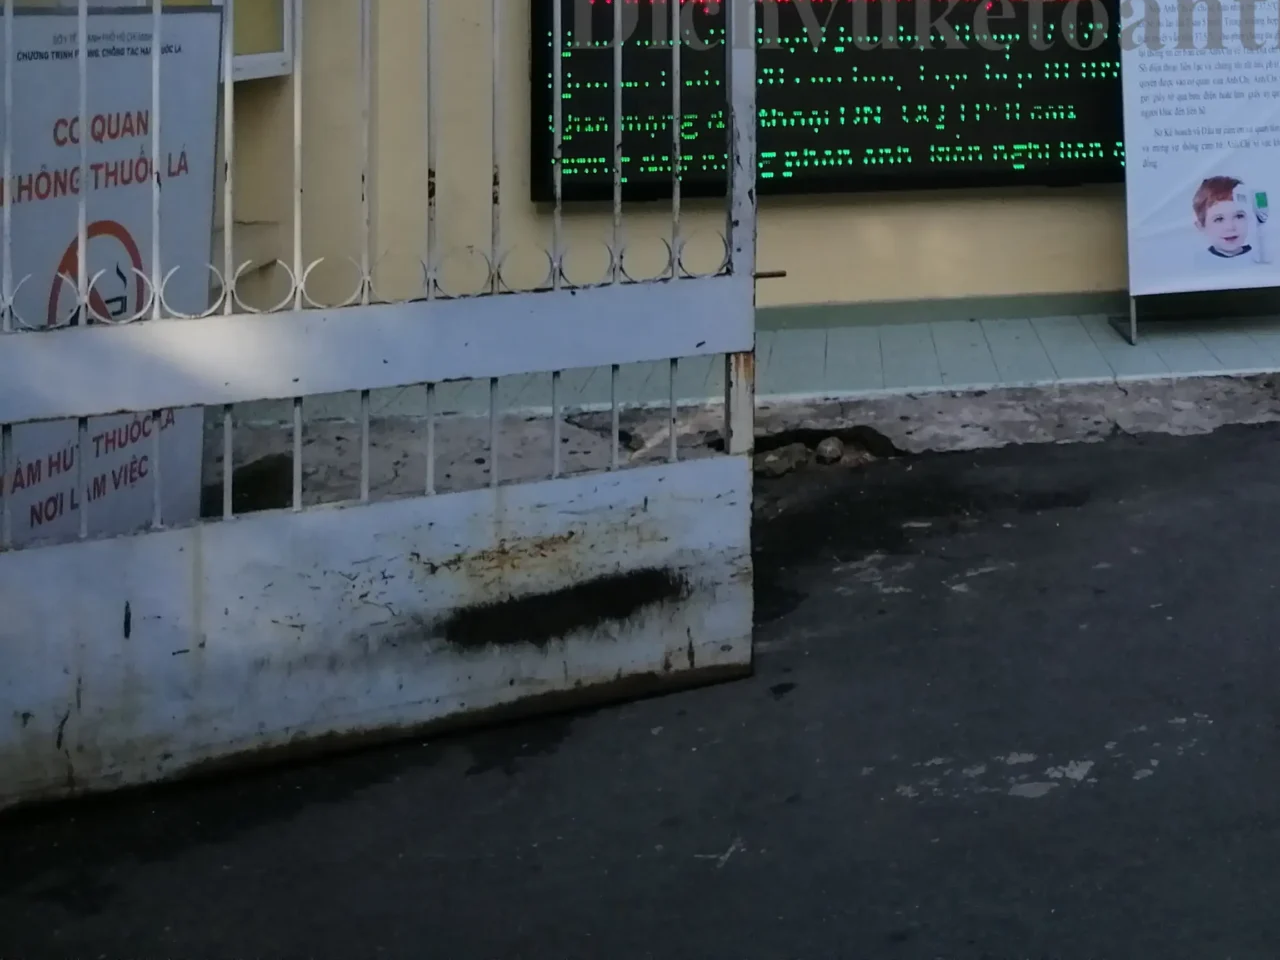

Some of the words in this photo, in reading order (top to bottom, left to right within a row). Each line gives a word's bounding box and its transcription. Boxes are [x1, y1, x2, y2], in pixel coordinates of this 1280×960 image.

[90, 109, 149, 144] QUAN
[167, 143, 189, 178] LÁ
[30, 492, 64, 529] NƠI
[111, 454, 149, 490] VIỆC
